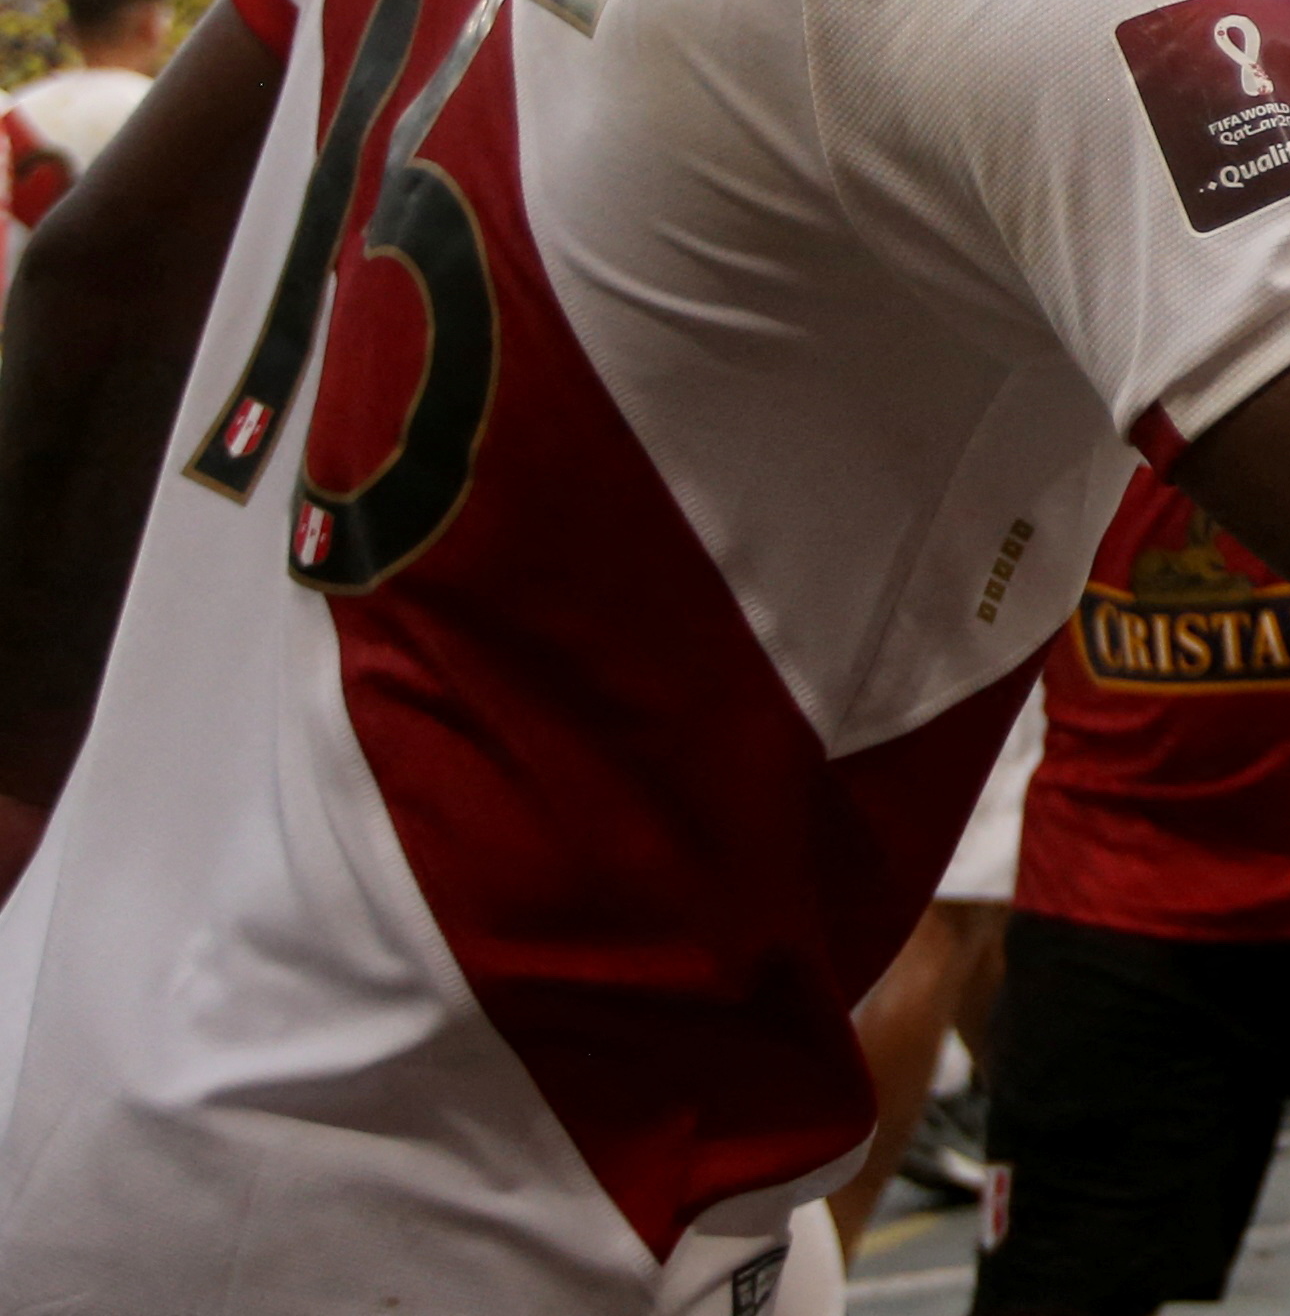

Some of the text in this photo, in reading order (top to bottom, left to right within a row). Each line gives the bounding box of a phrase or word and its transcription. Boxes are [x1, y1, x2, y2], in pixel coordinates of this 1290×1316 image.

[1208, 114, 1243, 136] FIFA
[1240, 102, 1290, 121] WORLD
[1219, 117, 1277, 145] Qatar
